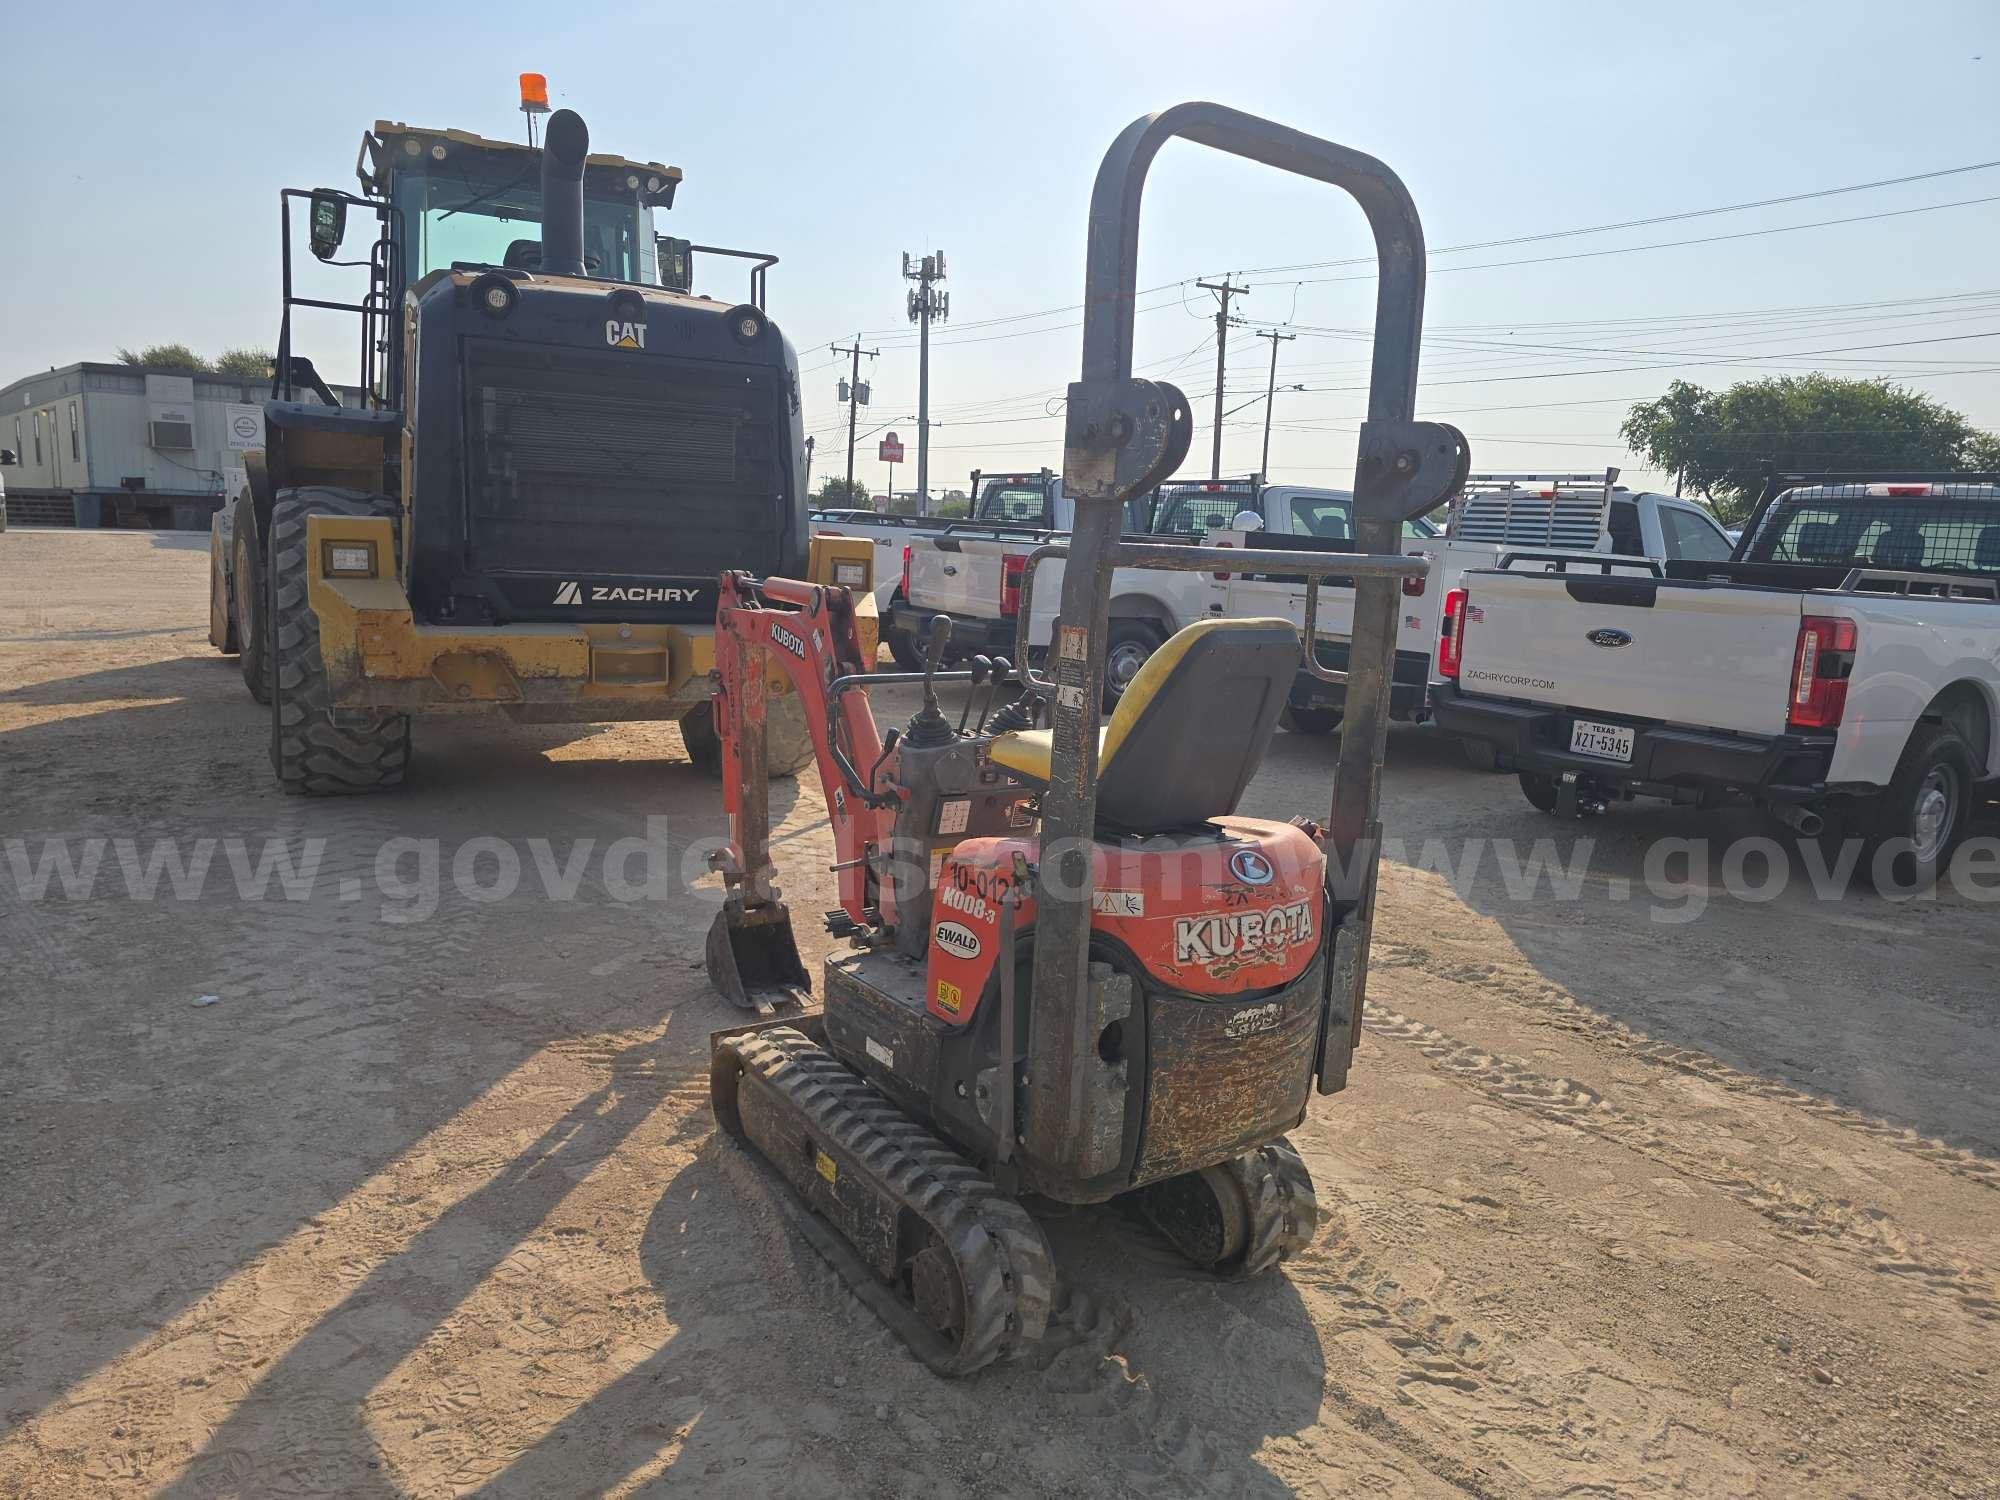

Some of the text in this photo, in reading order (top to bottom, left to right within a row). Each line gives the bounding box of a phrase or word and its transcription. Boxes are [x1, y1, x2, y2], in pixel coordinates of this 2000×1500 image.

[606, 320, 648, 349] CAT
[591, 587, 700, 602] ZACHRY
[770, 622, 806, 660] KUBOTA
[1592, 630, 1625, 646] Ford
[1466, 669, 1556, 690] ZACHRYCORP.COM
[1592, 725, 1617, 735] TEXAS
[936, 926, 977, 950] EWALD
[1176, 899, 1315, 964] KUBOTA
